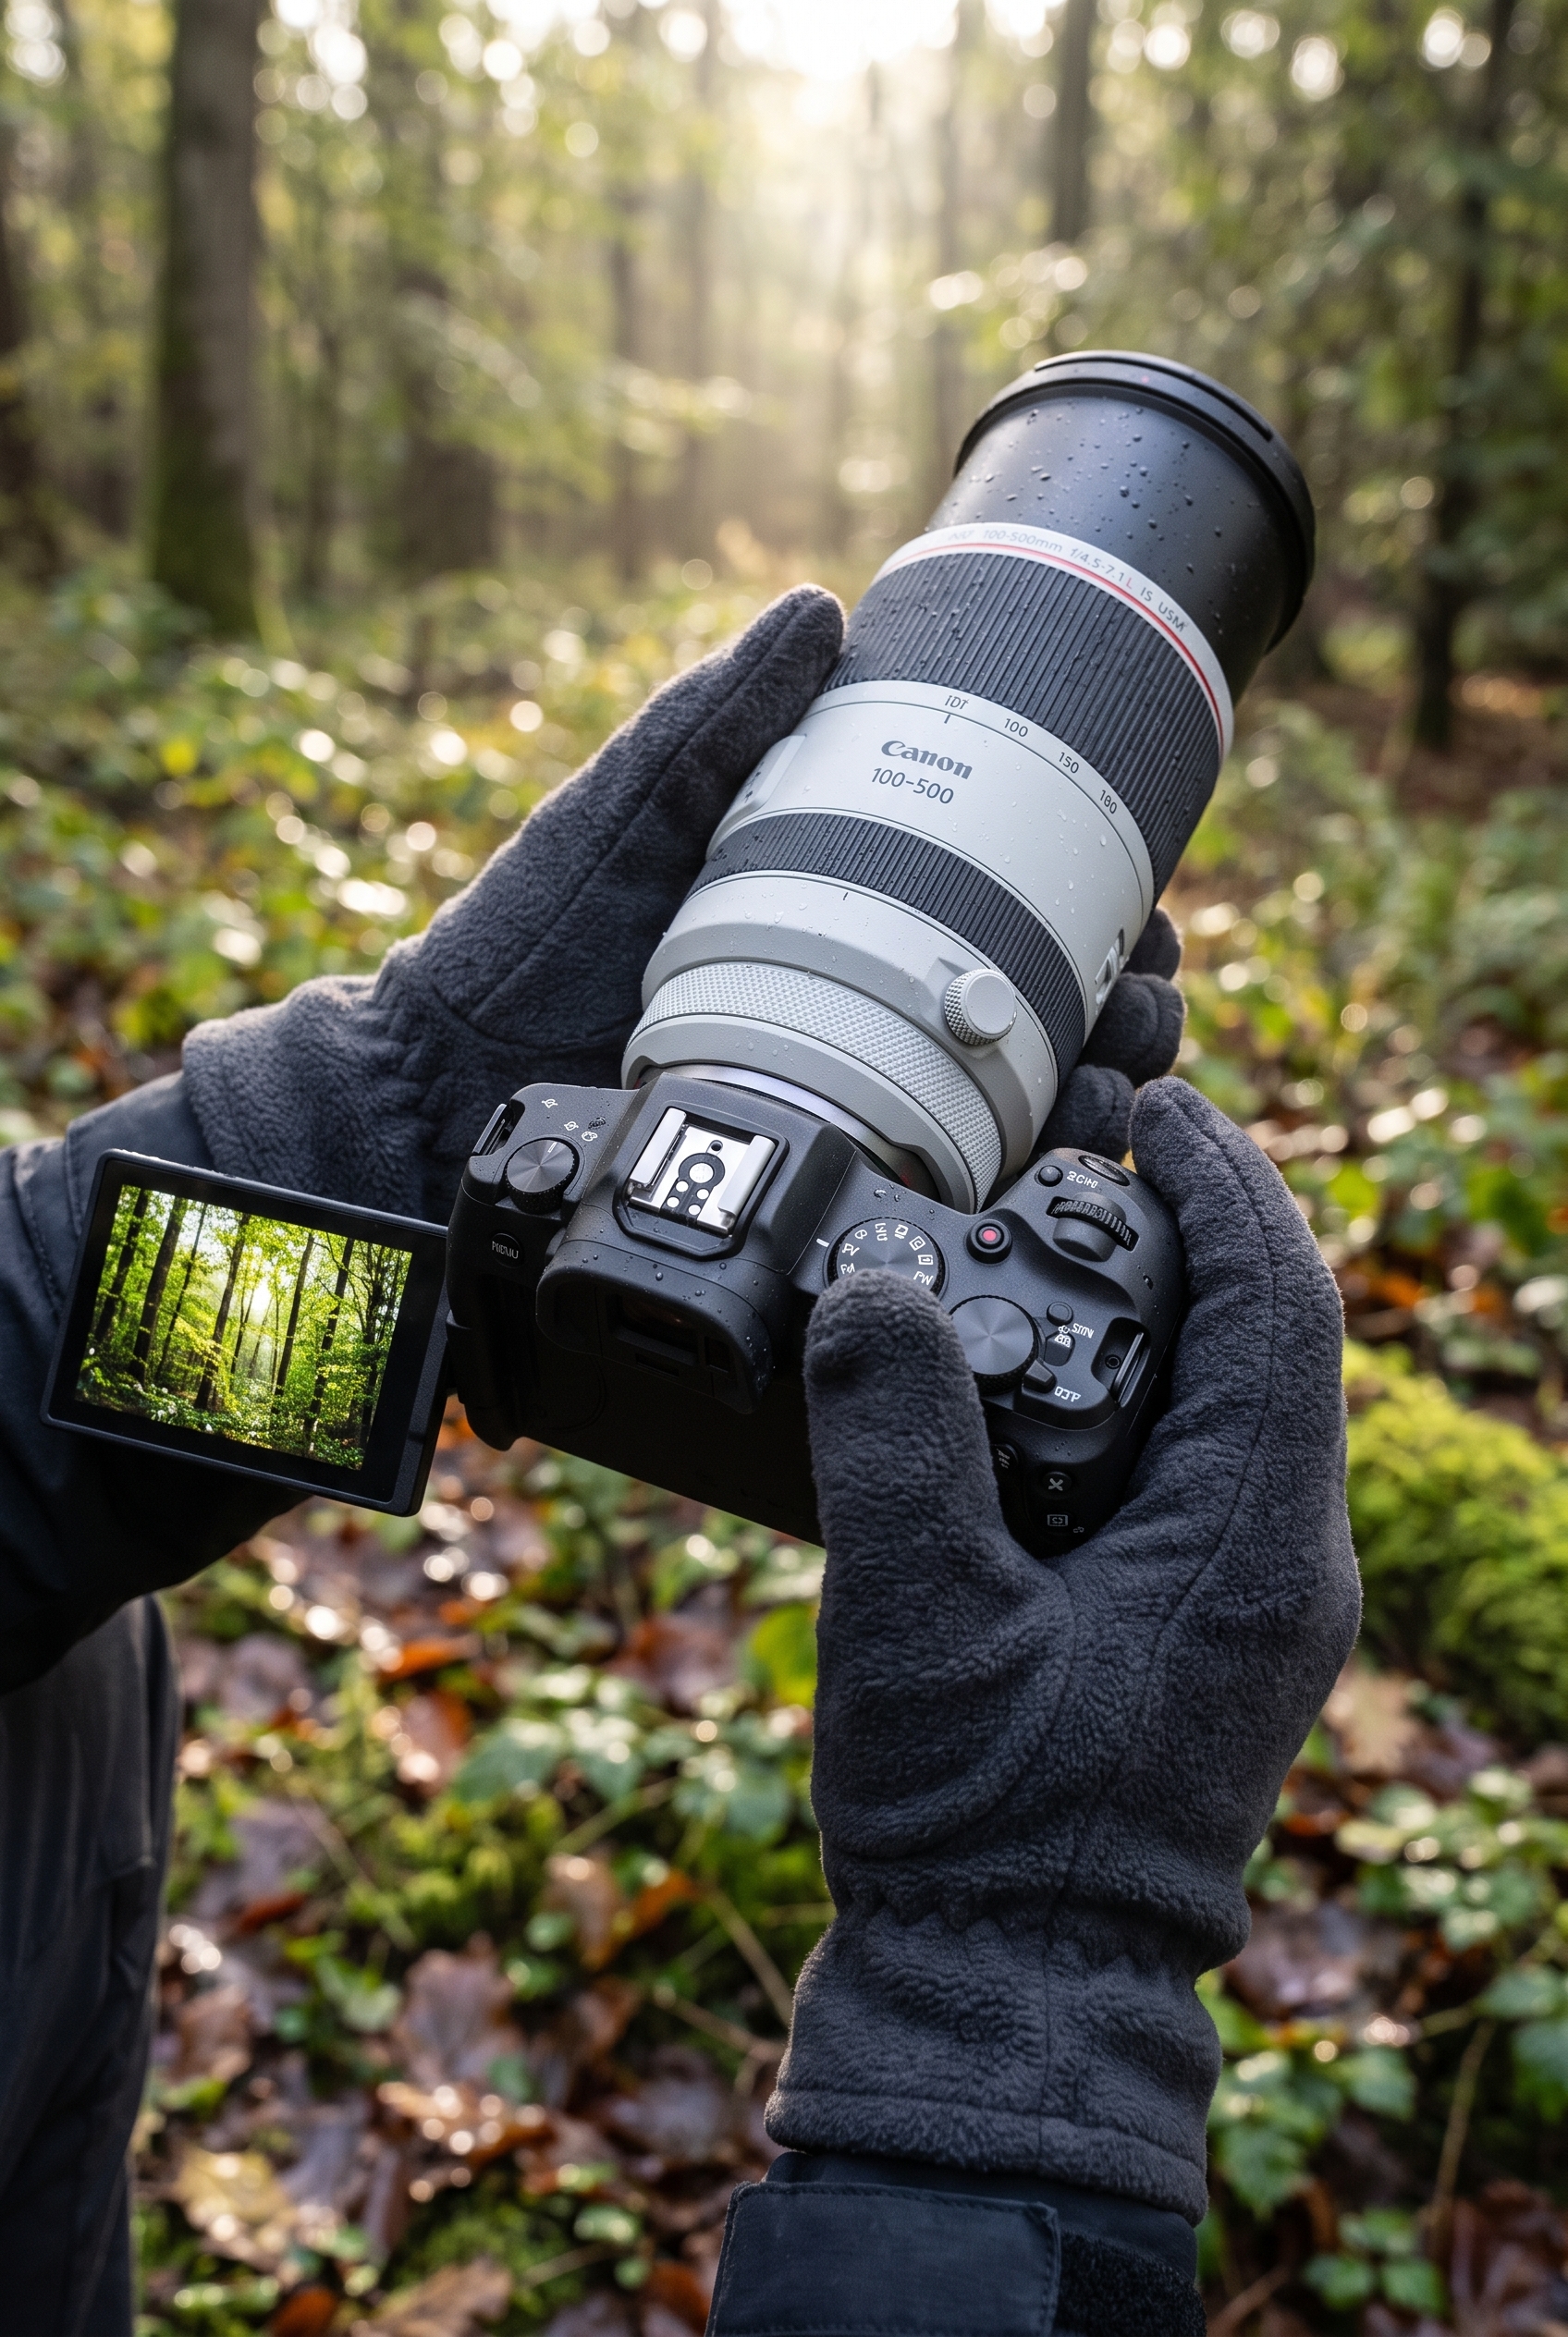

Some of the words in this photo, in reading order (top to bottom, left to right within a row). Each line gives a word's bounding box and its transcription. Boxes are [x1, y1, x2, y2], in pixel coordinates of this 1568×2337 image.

[983, 530, 1063, 553] 100-500mm
[1140, 587, 1153, 602] IS
[1158, 602, 1186, 632] USM
[1004, 718, 1028, 738] 100
[881, 740, 973, 779] Canon
[1059, 752, 1080, 774] 150
[872, 767, 954, 804] 100-500
